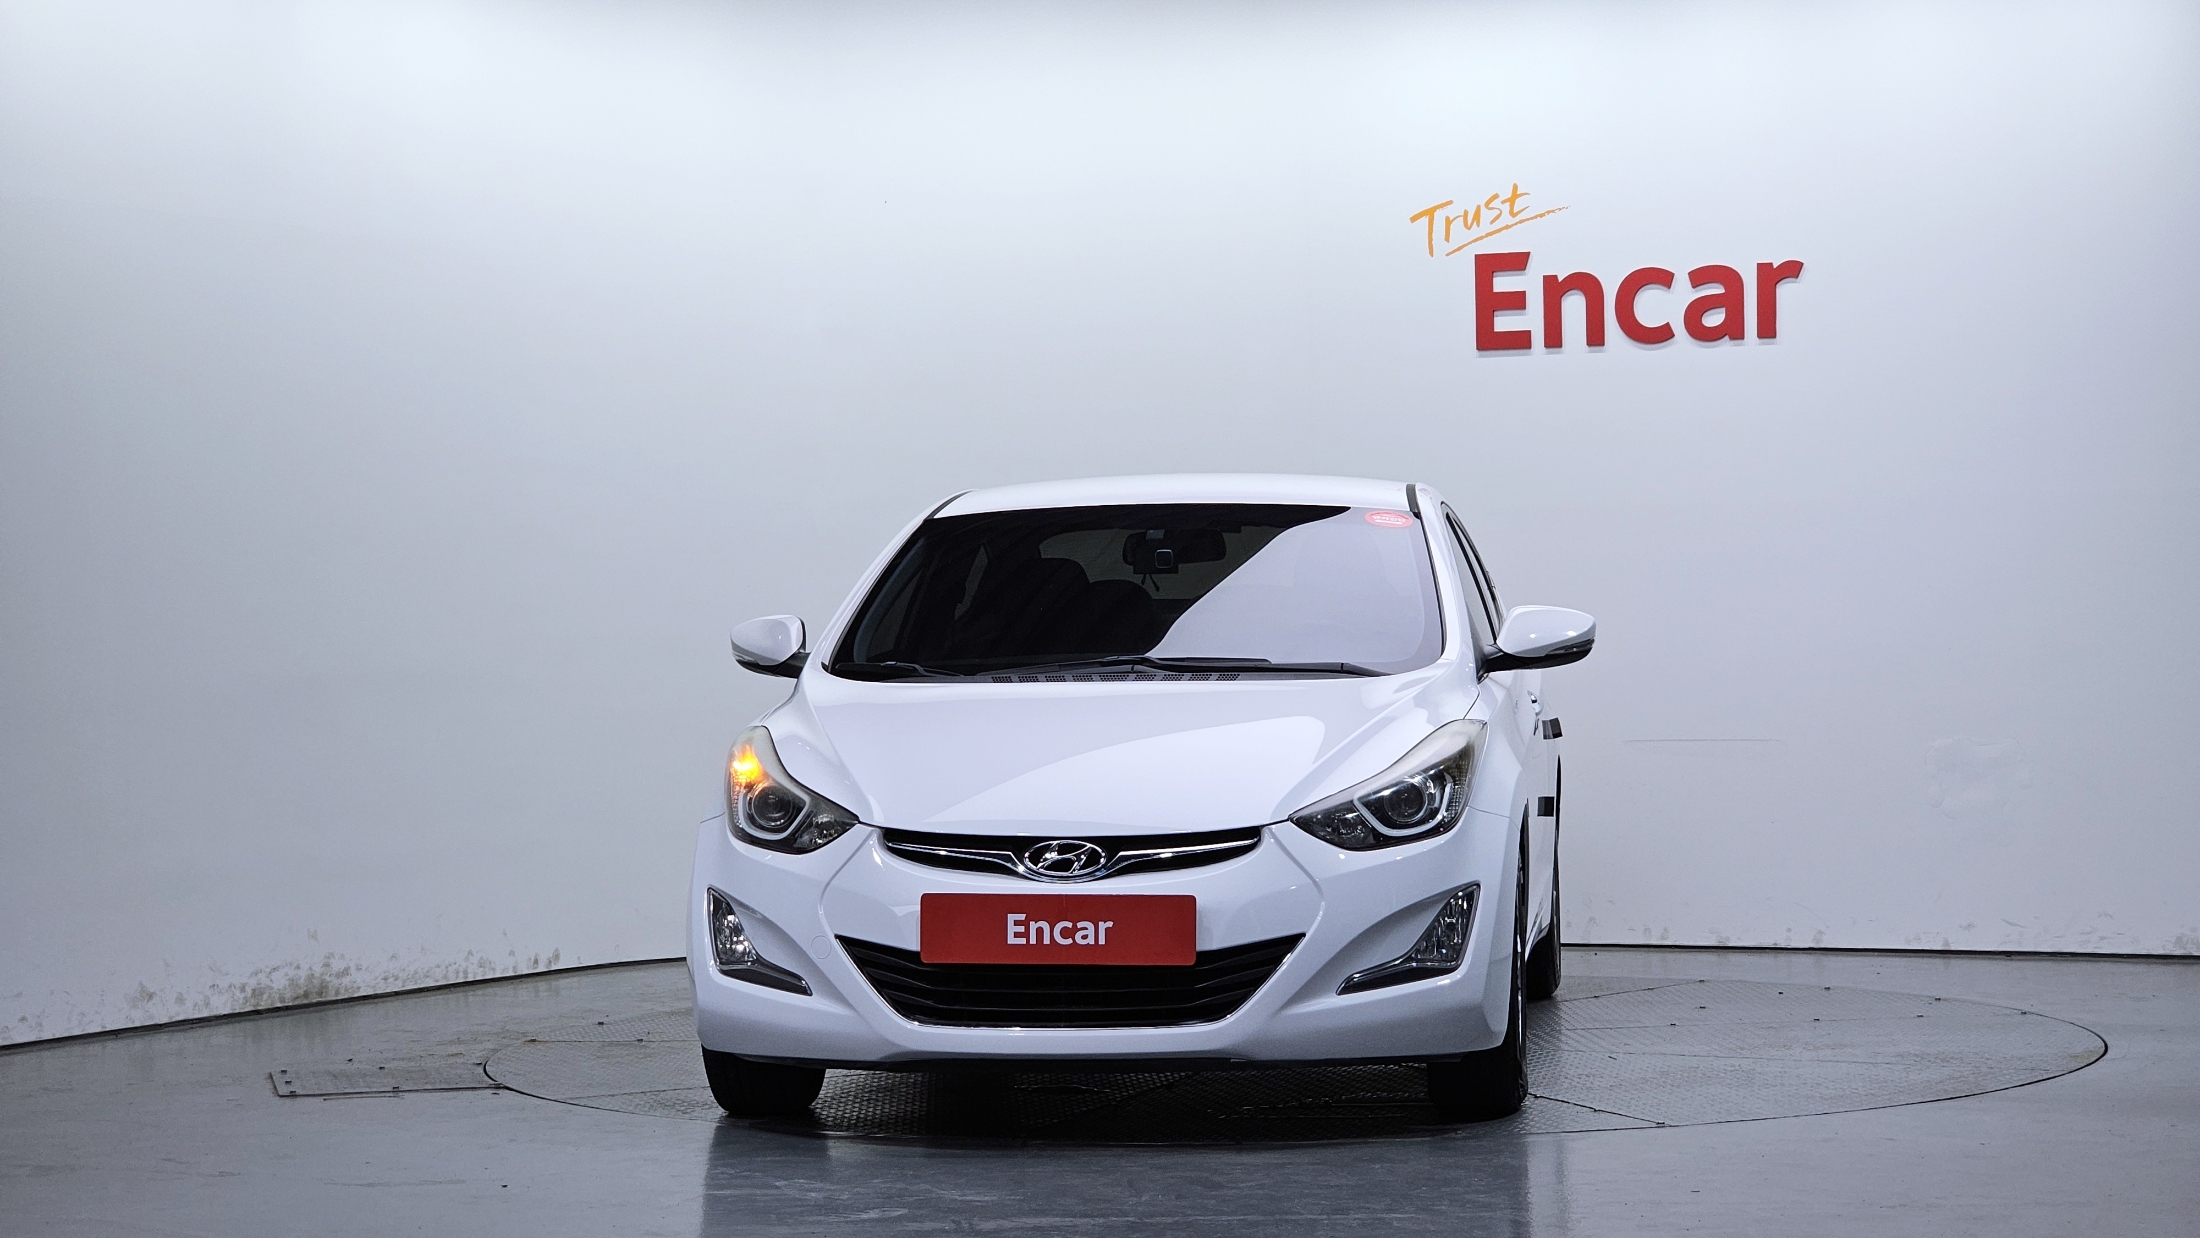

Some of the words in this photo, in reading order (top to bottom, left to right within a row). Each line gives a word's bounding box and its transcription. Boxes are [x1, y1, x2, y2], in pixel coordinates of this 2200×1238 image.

[1409, 183, 1531, 257] Trust
[1474, 251, 1804, 351] Encar
[1006, 913, 1114, 945] Encar
